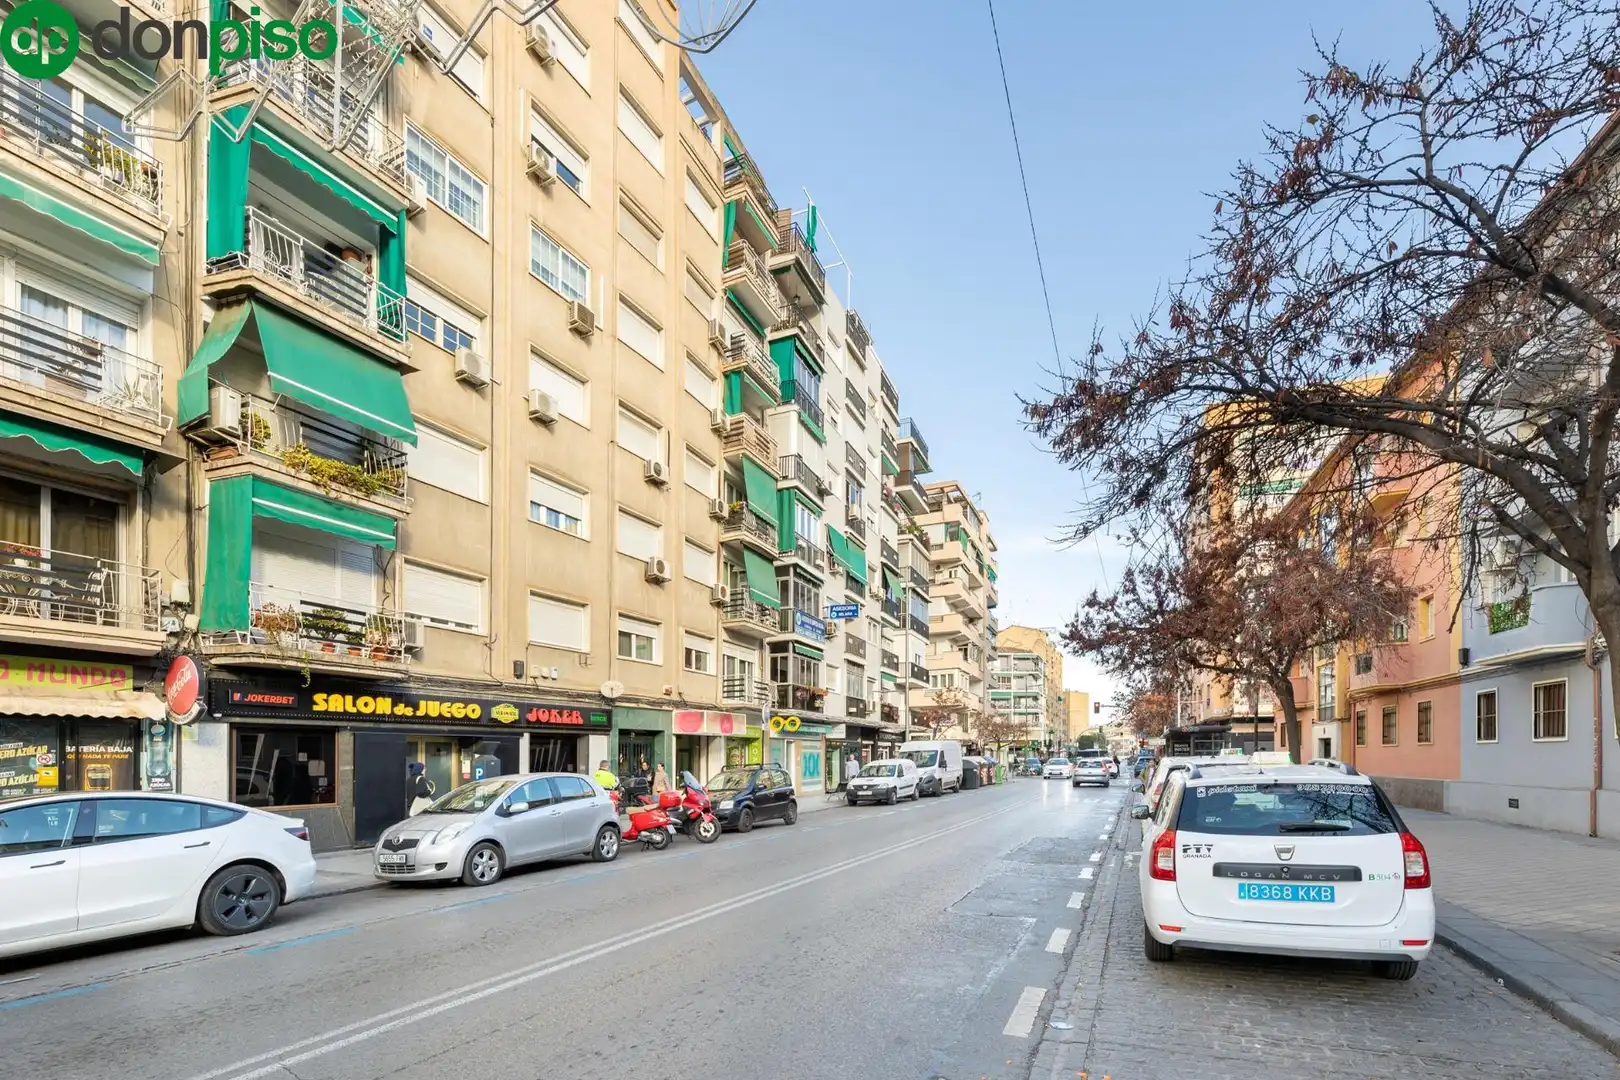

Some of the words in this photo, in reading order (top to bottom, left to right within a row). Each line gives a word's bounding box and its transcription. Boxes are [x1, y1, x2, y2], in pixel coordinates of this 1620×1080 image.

[26, 662, 127, 688] MUNDO
[244, 692, 295, 705] JOKERBET
[312, 692, 392, 715] SALON
[393, 703, 413, 716] de
[416, 700, 482, 719] JUEGO
[525, 707, 584, 725] JOKER
[475, 768, 484, 780] P
[1227, 871, 1290, 879] LOGAN
[1250, 884, 1292, 900] 8368
[1298, 886, 1332, 901] KKB
